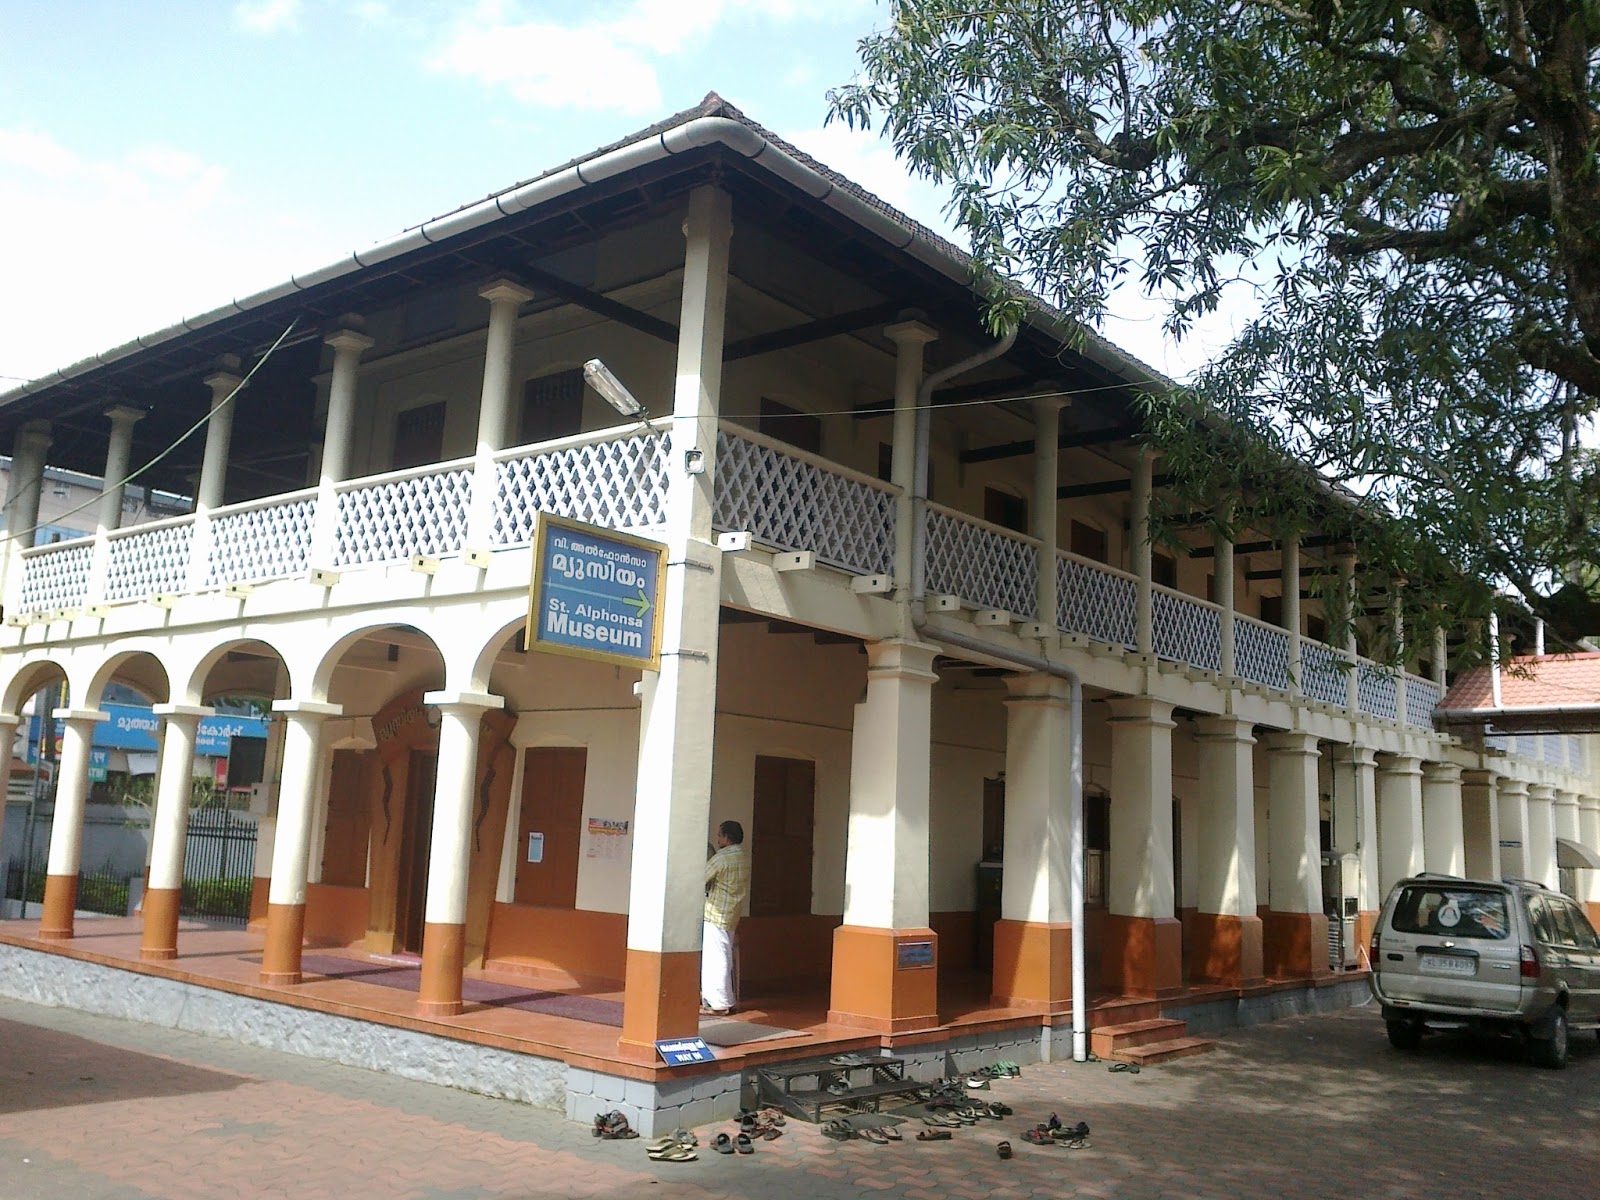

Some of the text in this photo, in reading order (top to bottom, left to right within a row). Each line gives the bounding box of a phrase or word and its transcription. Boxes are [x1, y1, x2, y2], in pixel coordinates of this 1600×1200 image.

[547, 610, 642, 649] Museum
[549, 598, 643, 628] St. Alphonsa
